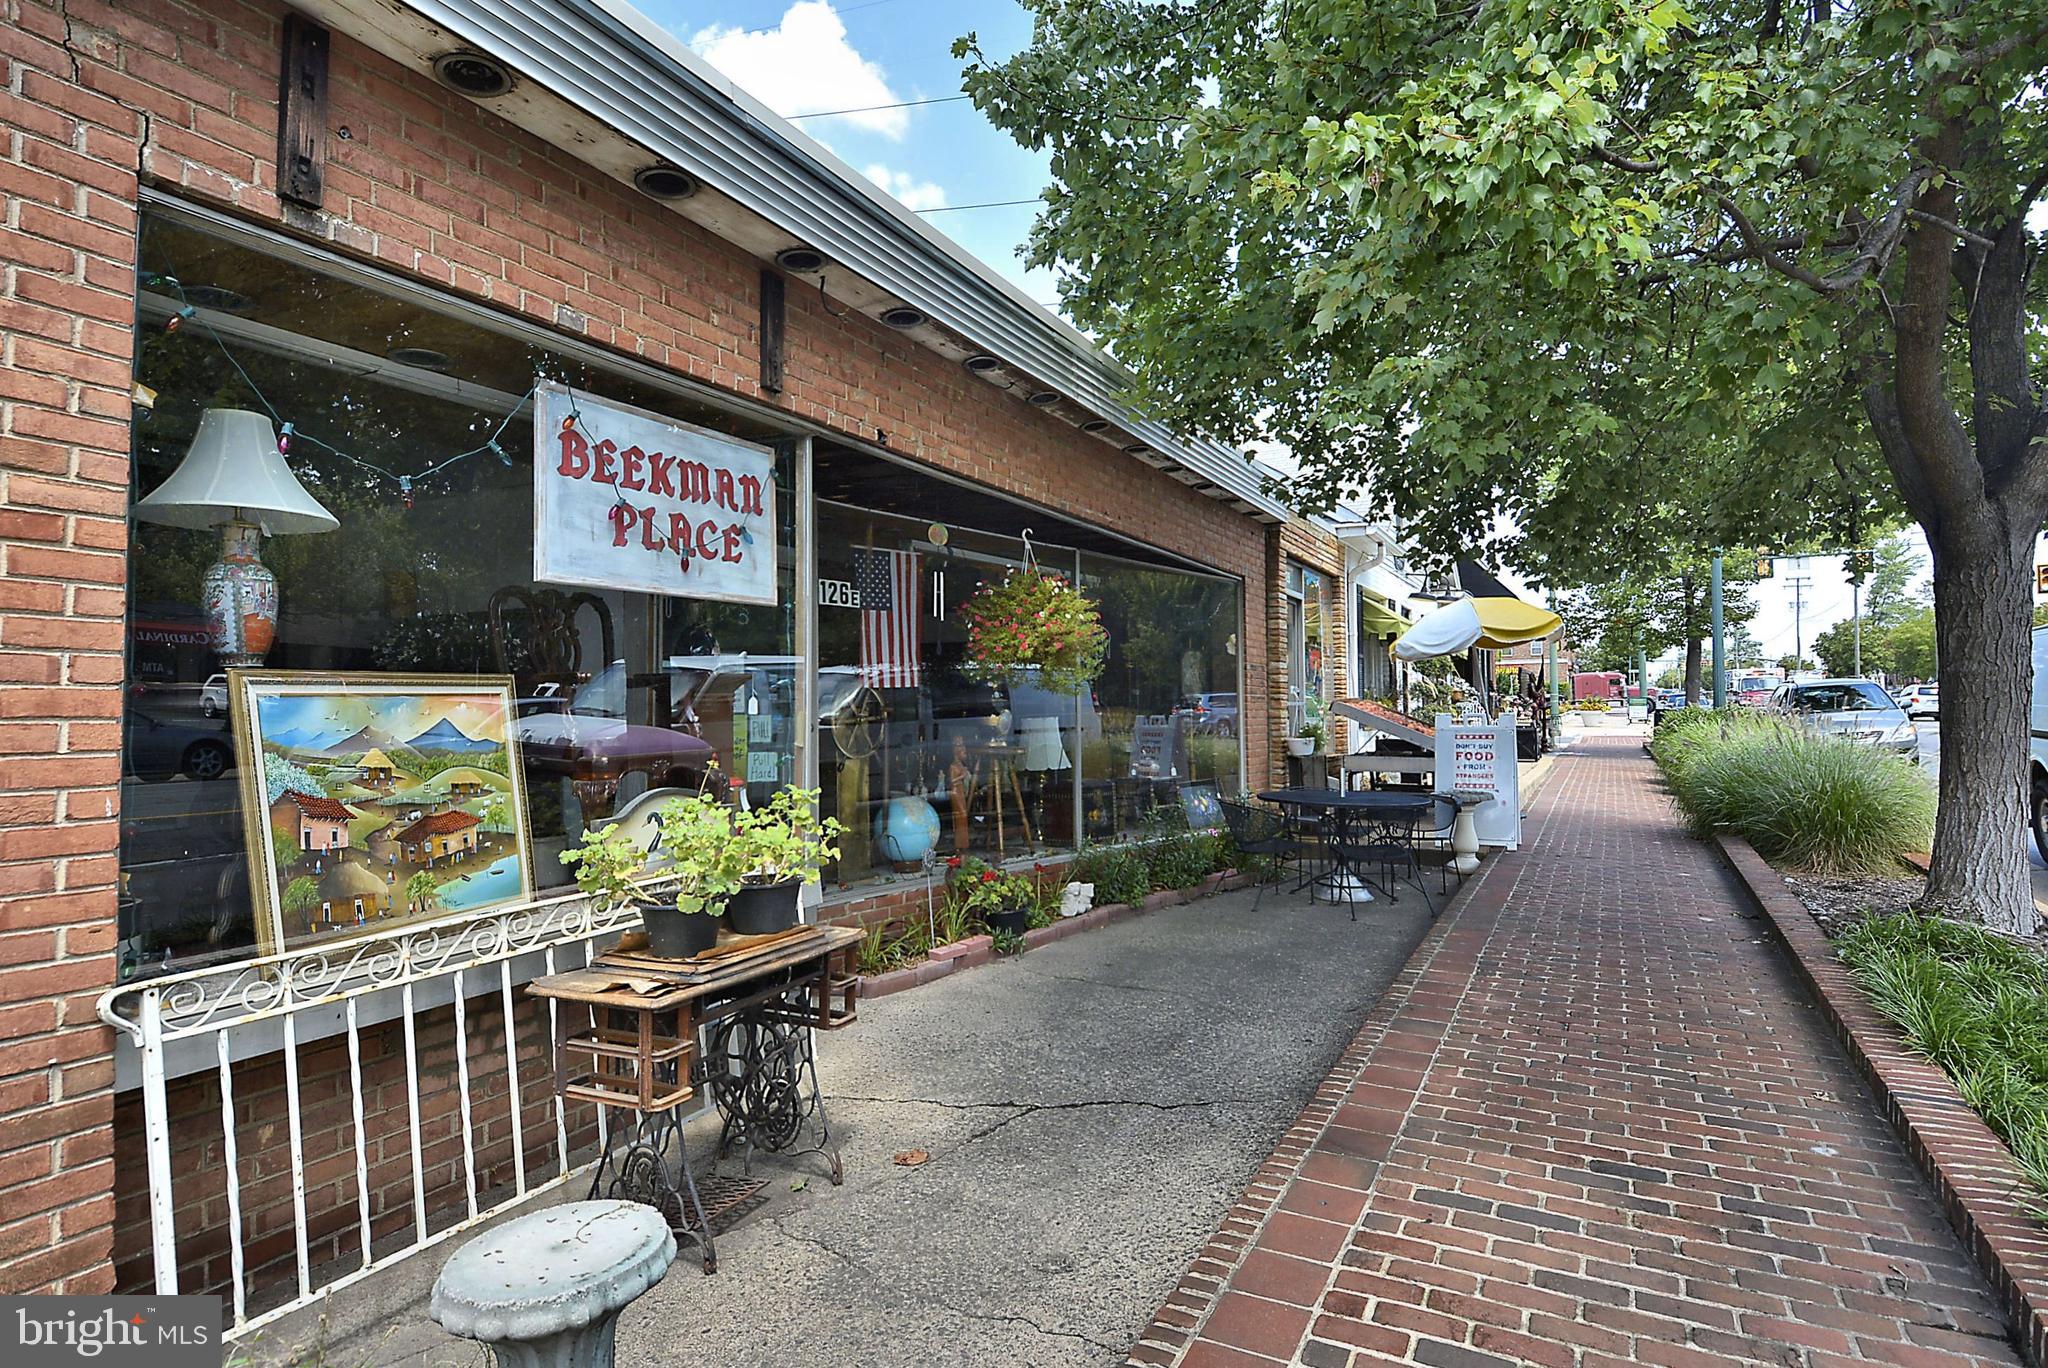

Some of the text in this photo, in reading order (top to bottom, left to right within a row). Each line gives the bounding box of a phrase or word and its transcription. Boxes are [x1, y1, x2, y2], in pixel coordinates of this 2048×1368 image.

[557, 429, 763, 516] BEEKMAN
[612, 502, 743, 563] PLACE
[820, 580, 859, 606] 126E
[1455, 751, 1494, 761] FOOD
